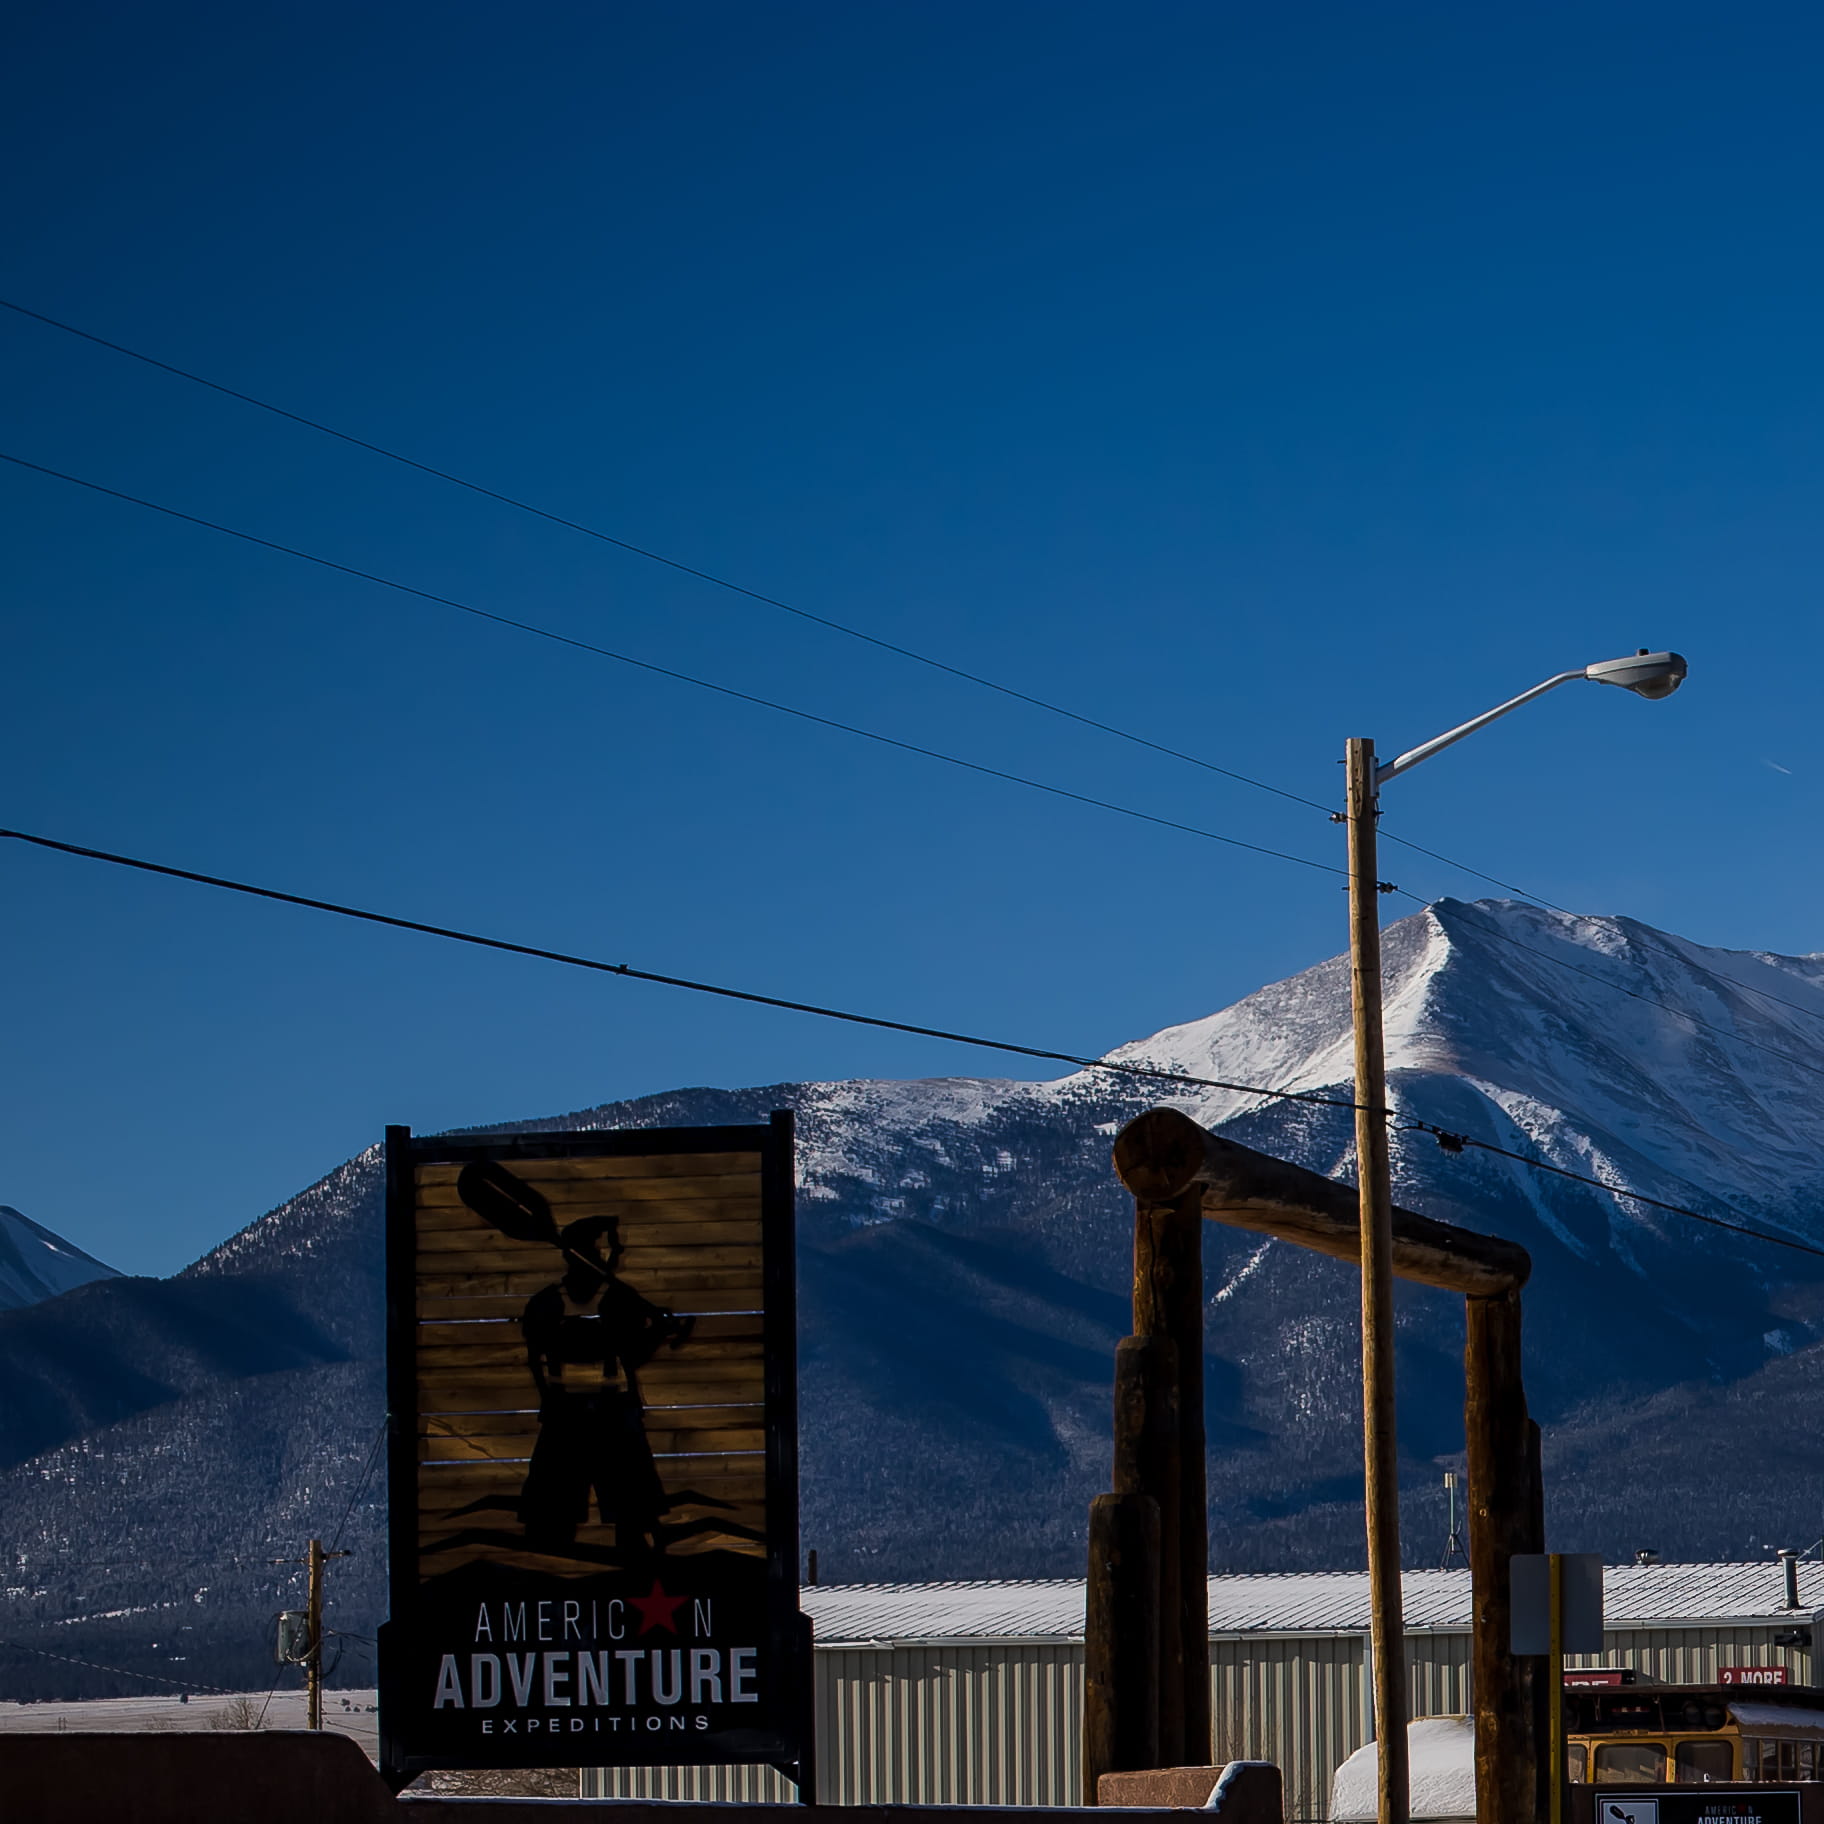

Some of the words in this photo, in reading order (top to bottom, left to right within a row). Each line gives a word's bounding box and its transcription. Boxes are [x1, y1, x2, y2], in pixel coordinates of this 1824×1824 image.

[433, 1647, 759, 1710] ADVENTURE
[1740, 1670, 1784, 1684] MORE
[481, 1715, 711, 1735] EXPEDITIONS
